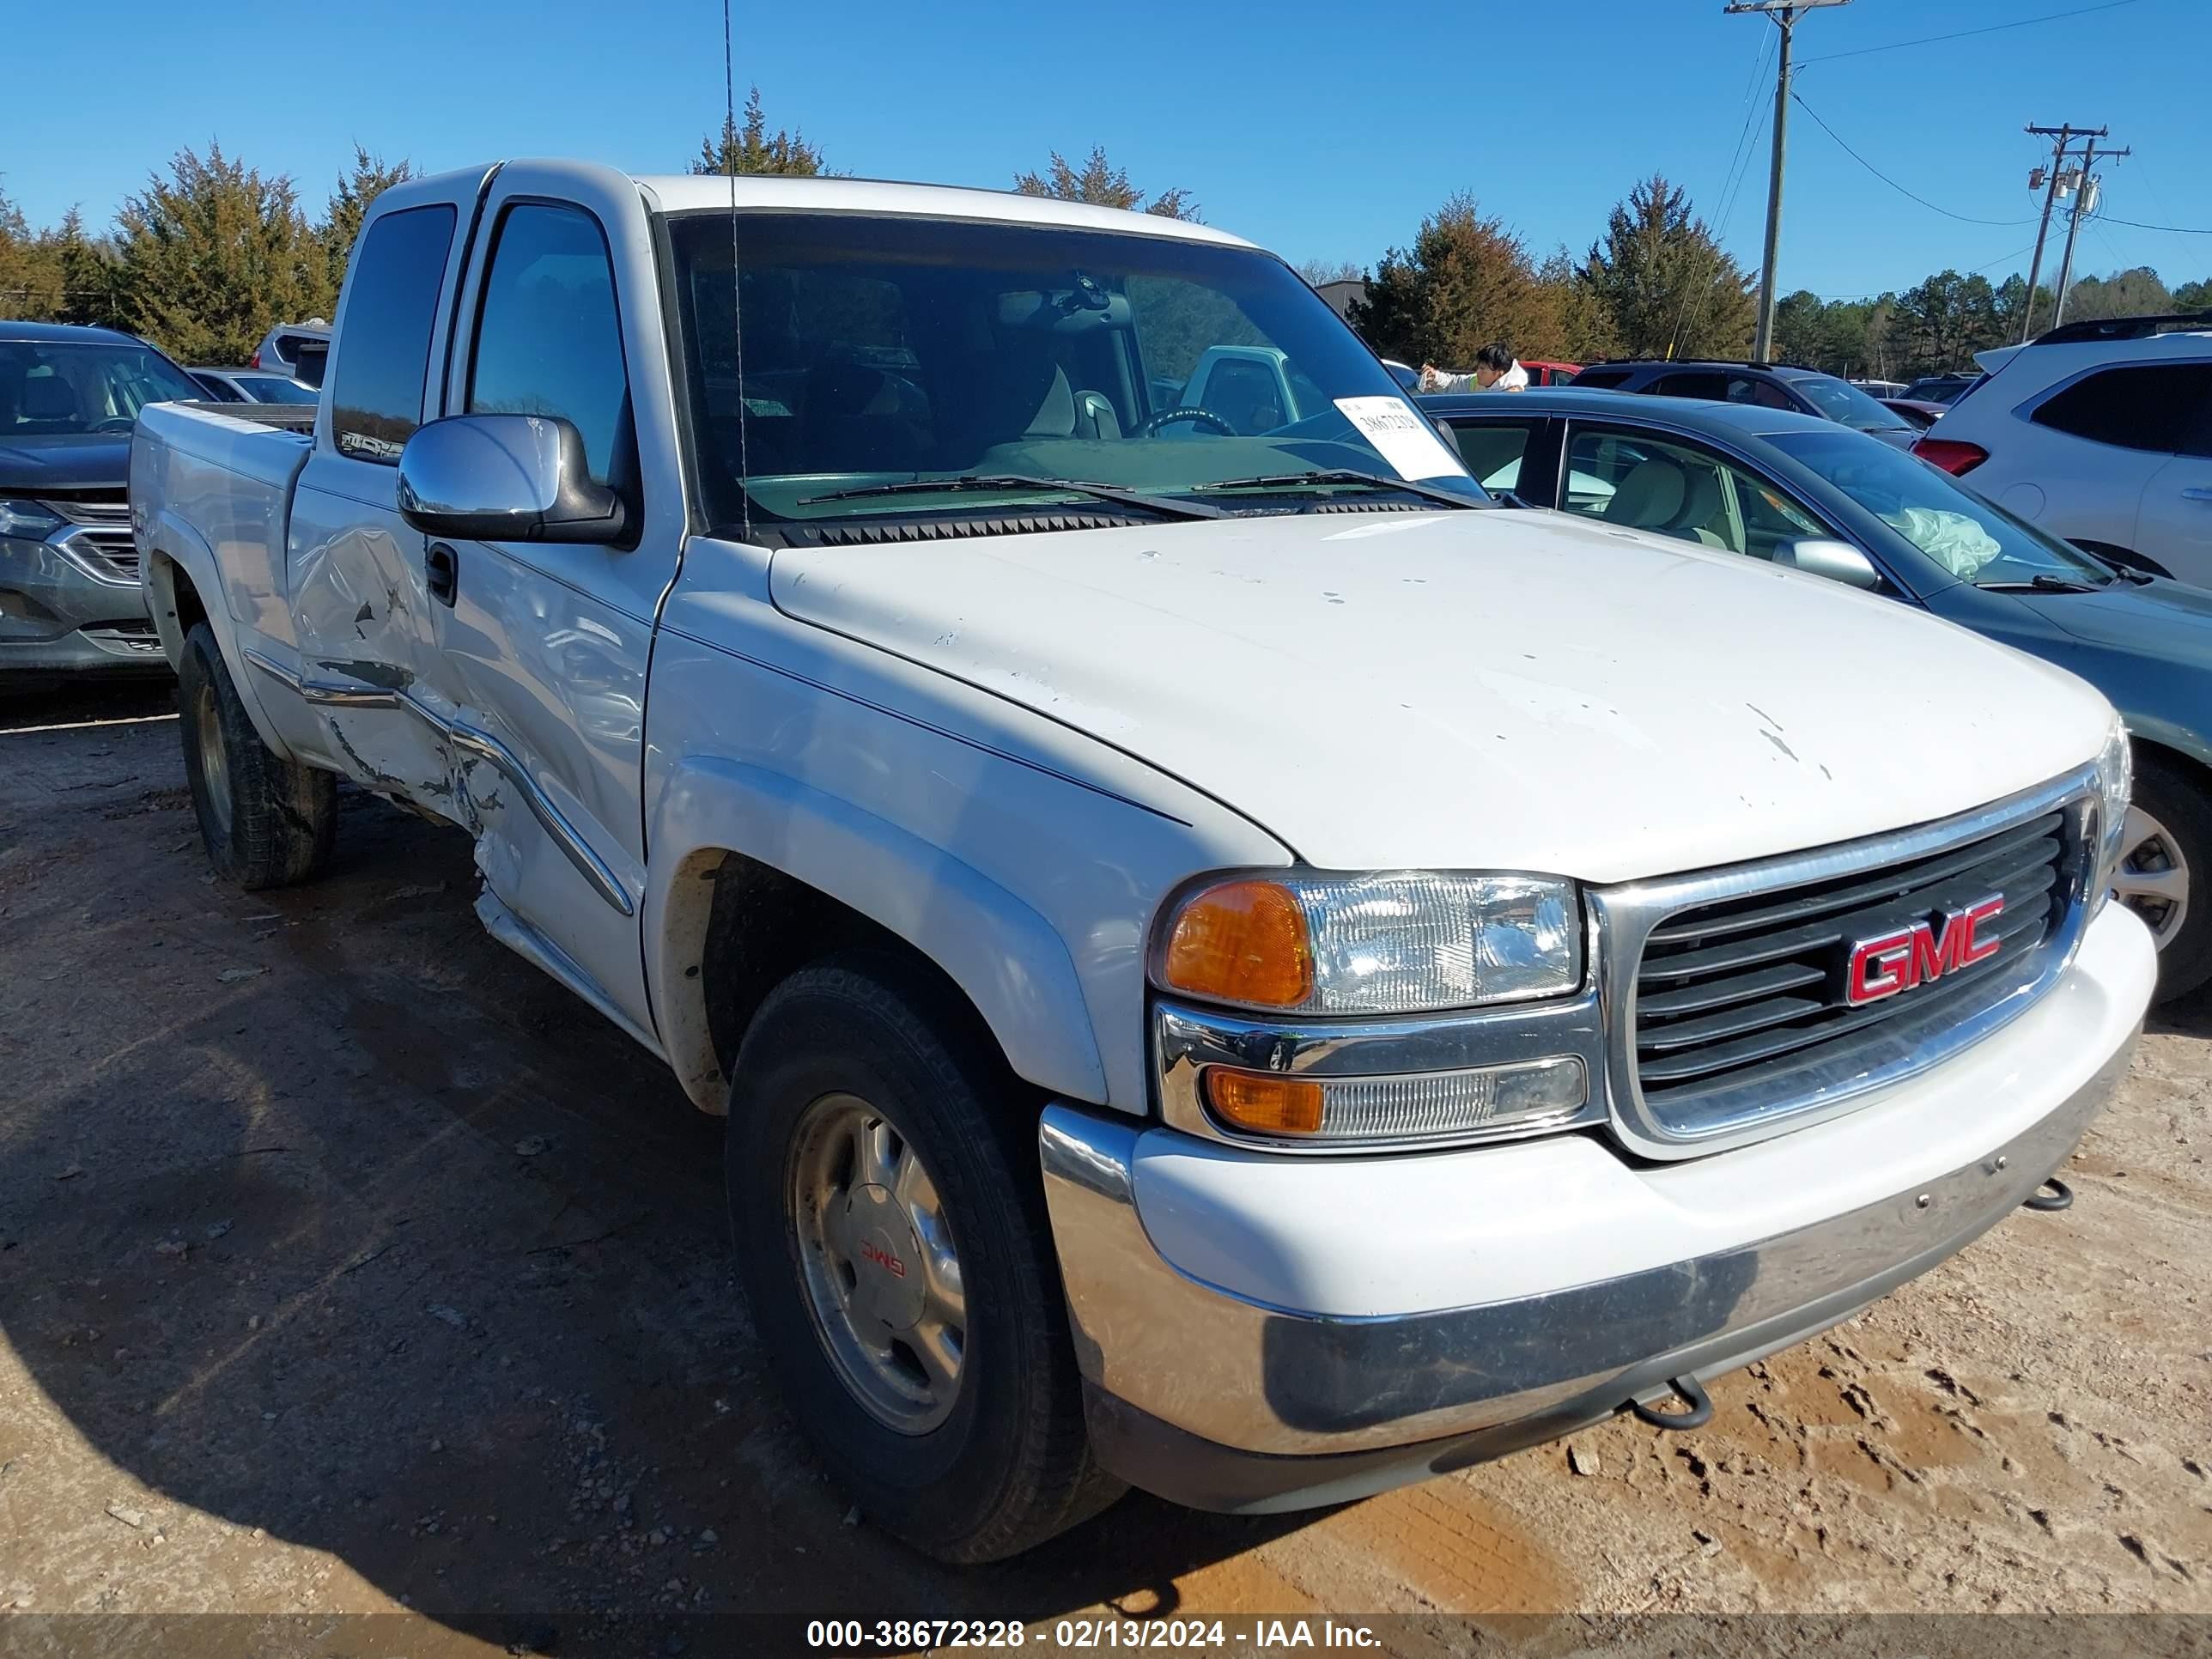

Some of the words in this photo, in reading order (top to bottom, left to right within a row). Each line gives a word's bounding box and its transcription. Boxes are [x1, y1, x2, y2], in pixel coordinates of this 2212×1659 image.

[1359, 415, 1419, 432] 38672328
[1846, 892, 2005, 1008] GMC
[860, 1240, 906, 1279] GMC
